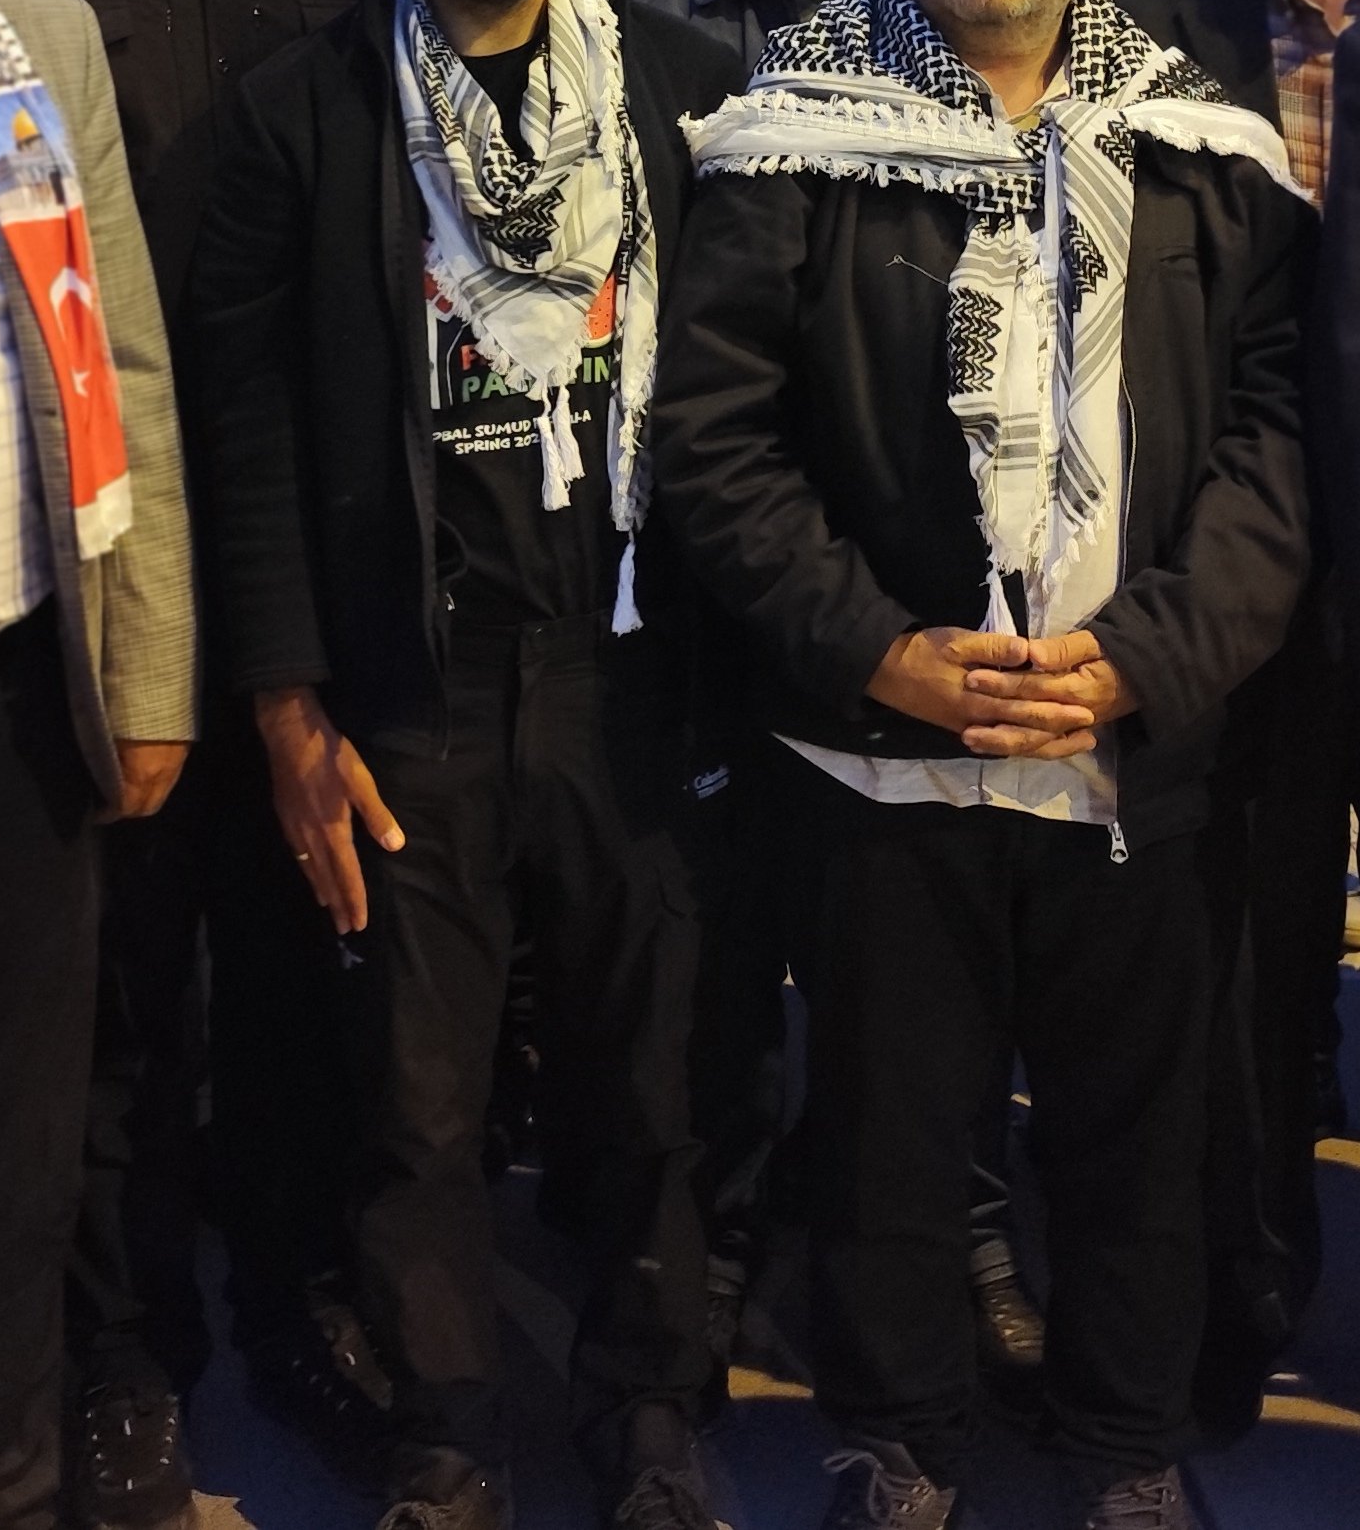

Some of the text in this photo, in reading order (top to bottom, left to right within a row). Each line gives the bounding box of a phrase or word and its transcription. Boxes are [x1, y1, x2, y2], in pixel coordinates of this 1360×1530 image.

[474, 419, 531, 437] SUMUD
[454, 432, 541, 455] SPRING 202
